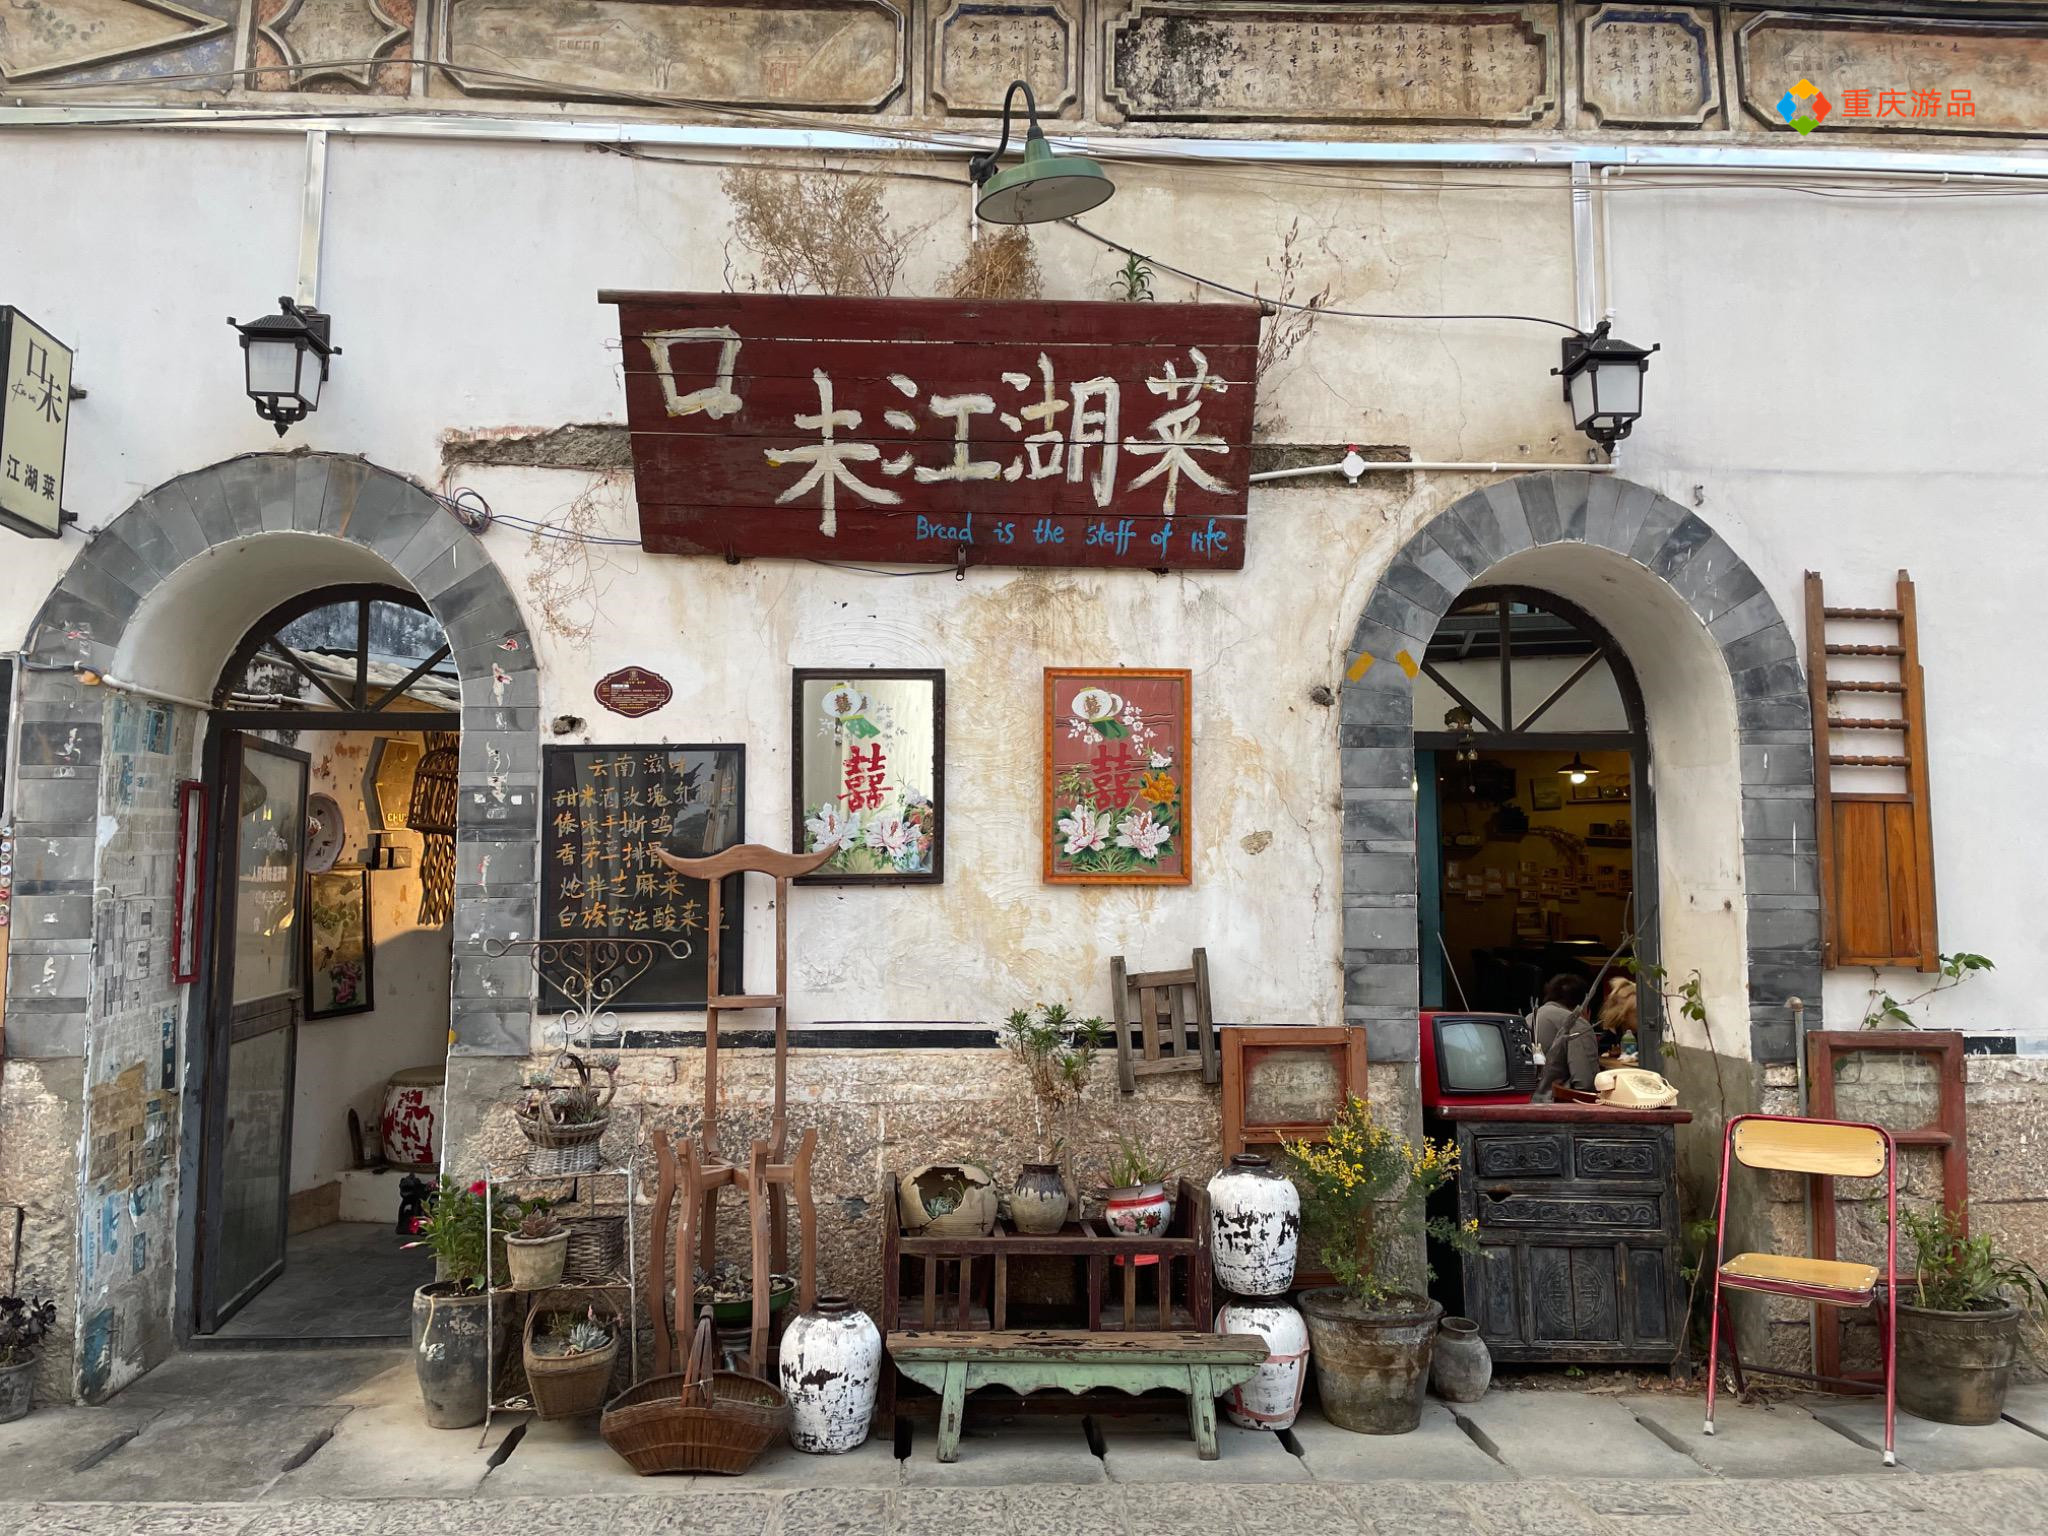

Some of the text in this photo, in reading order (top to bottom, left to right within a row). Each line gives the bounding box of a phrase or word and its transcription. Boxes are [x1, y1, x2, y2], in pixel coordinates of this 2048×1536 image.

[7, 454, 57, 501] 江湖菜
[916, 511, 1230, 560] Bread is the staff of life
[588, 756, 687, 779] 云南滋味
[553, 808, 674, 841] 傣味手撕鸡
